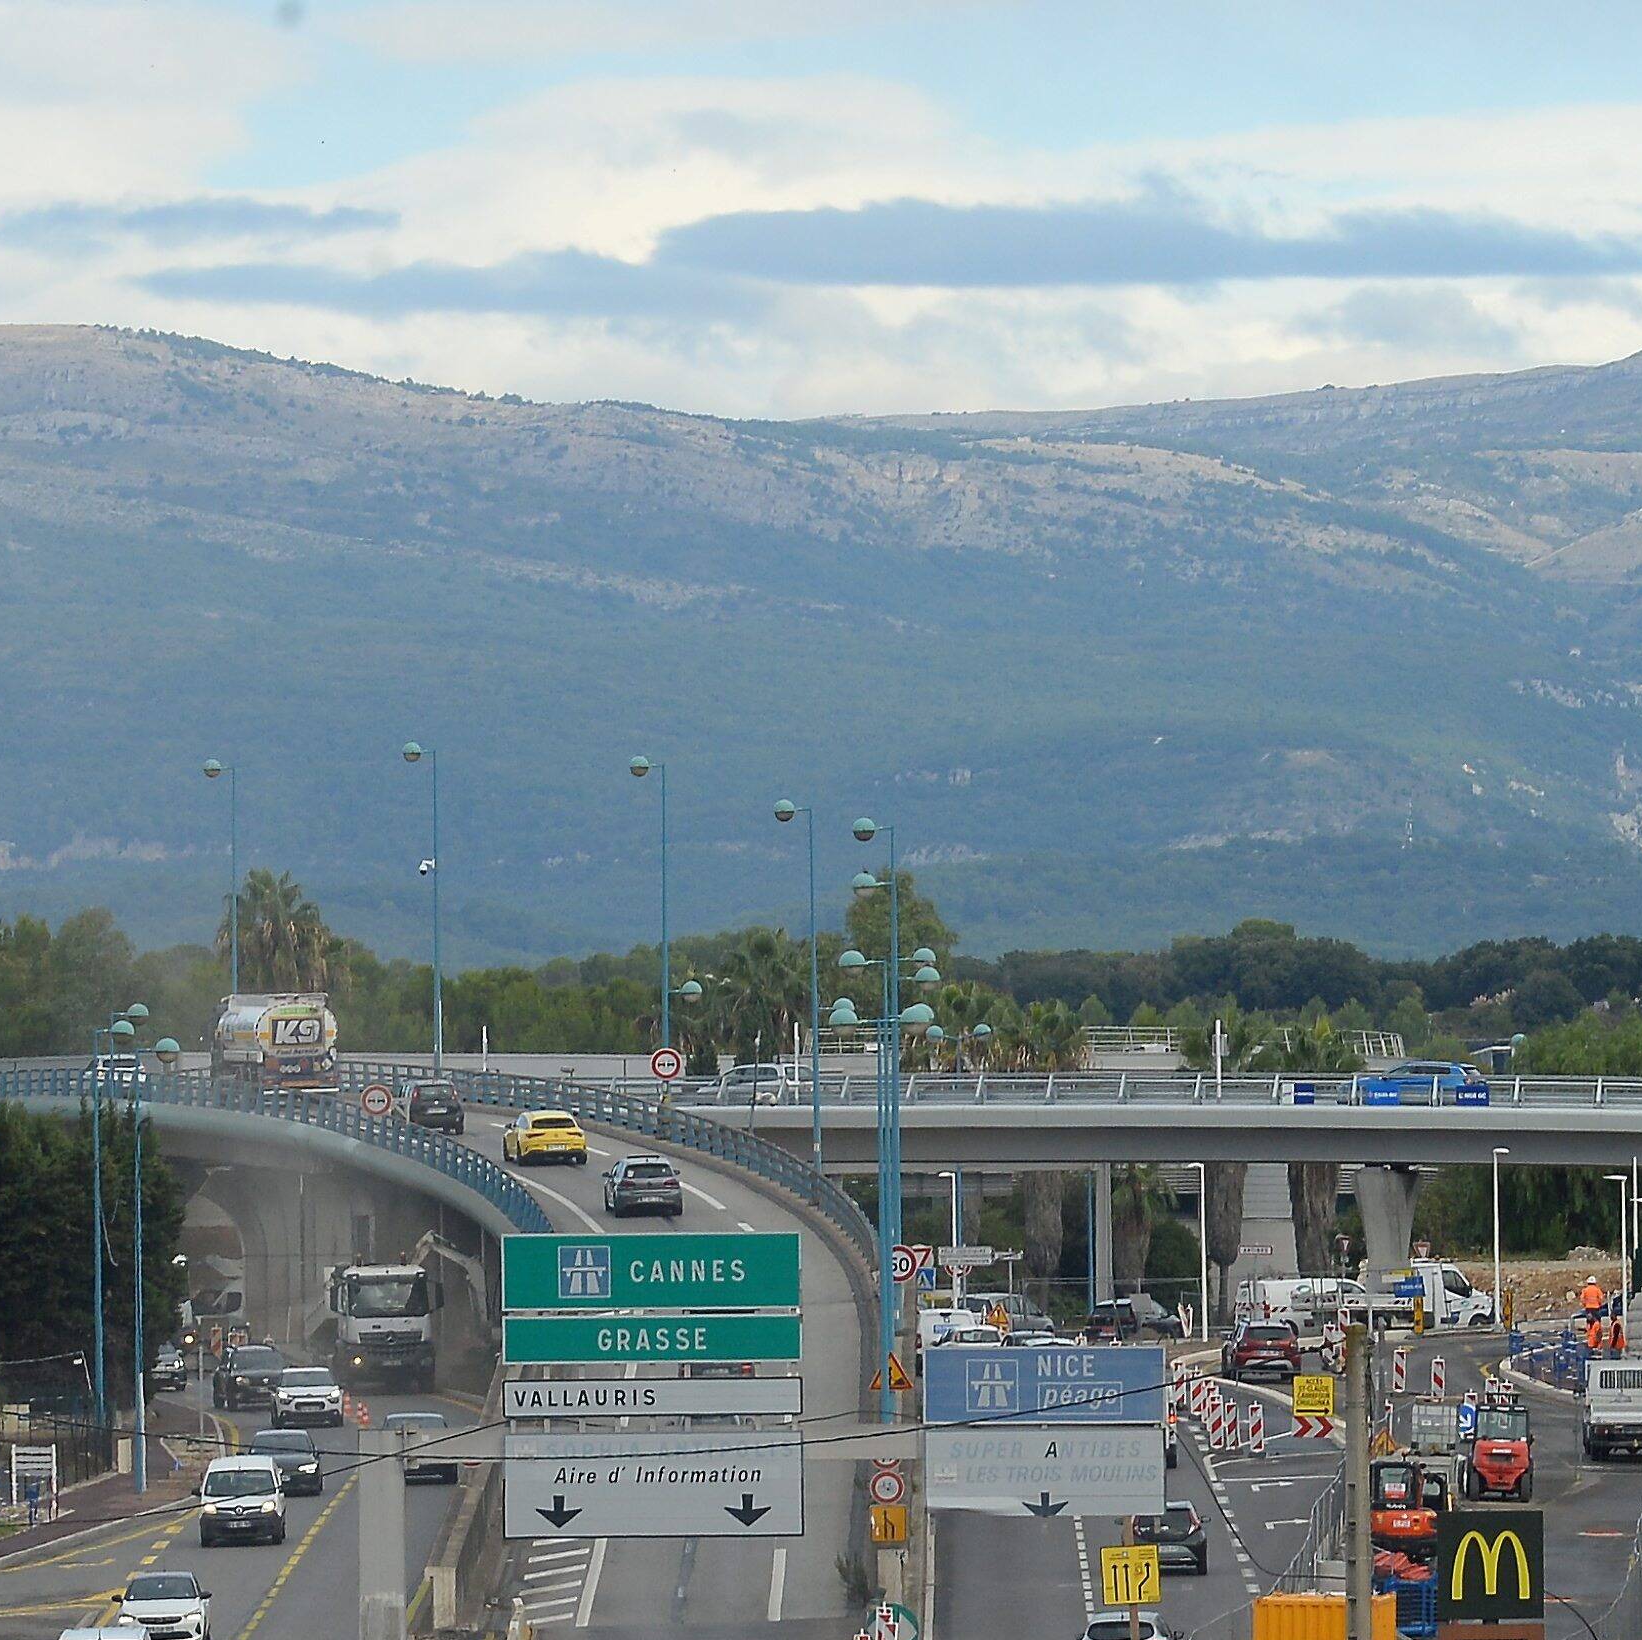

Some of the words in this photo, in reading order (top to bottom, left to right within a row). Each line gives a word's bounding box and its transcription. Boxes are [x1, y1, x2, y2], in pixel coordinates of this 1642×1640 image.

[630, 1259, 747, 1283] CANNES
[597, 1327, 708, 1351] GRASSE
[1038, 1354, 1095, 1377] NICE
[514, 1388, 657, 1407] VALLAURIS
[1044, 1385, 1118, 1408] péage
[1045, 1441, 1142, 1459] ANTIBES
[554, 1467, 597, 1484] Aire
[636, 1464, 762, 1484] Information
[1069, 1465, 1157, 1483] MOULINS
